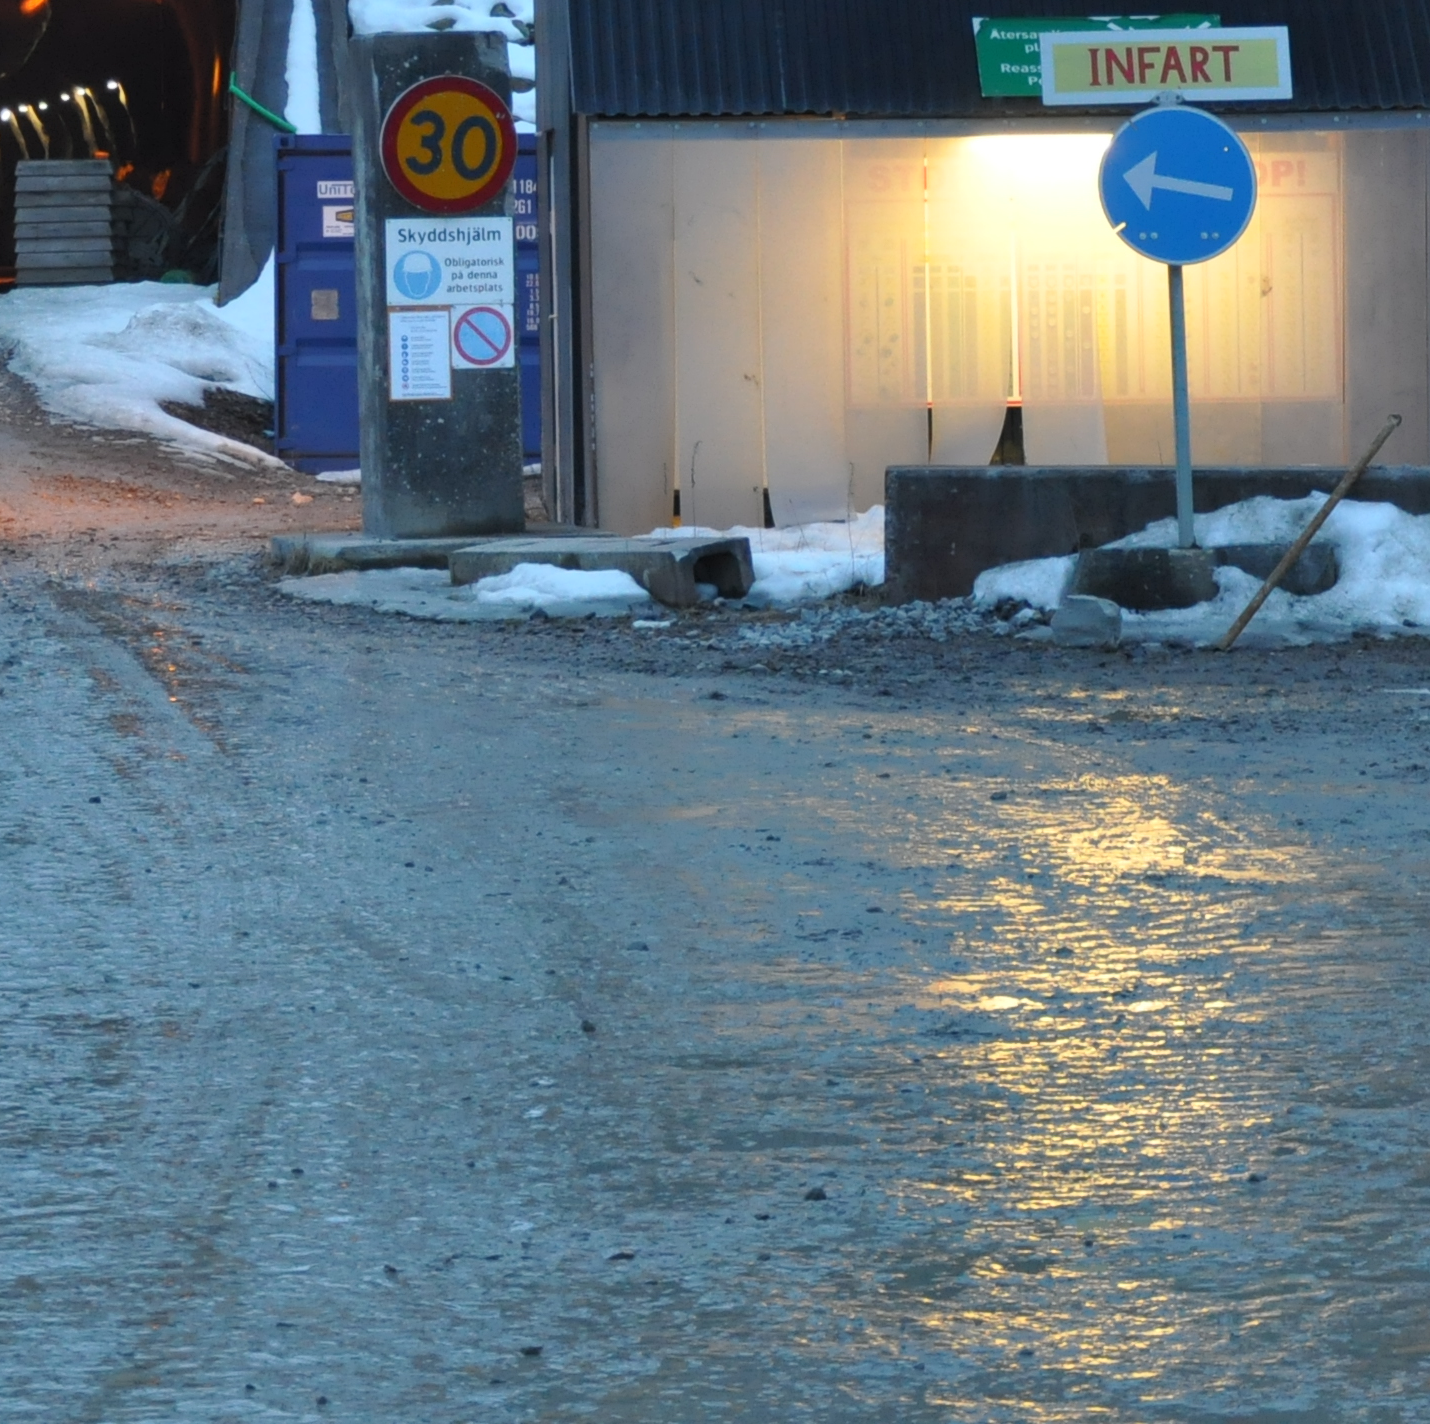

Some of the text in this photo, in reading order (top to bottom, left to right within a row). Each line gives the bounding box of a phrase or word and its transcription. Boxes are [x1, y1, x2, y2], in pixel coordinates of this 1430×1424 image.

[990, 28, 1039, 40] Återsa
[1024, 42, 1041, 54] pl
[1000, 63, 1042, 73] Reass
[1088, 45, 1240, 87] INFART
[406, 109, 497, 181] 30
[397, 227, 501, 246] Skyddshjälm
[444, 258, 505, 268] Obligatorisk
[451, 270, 498, 281] på denna
[446, 283, 503, 294] arbetsplats
